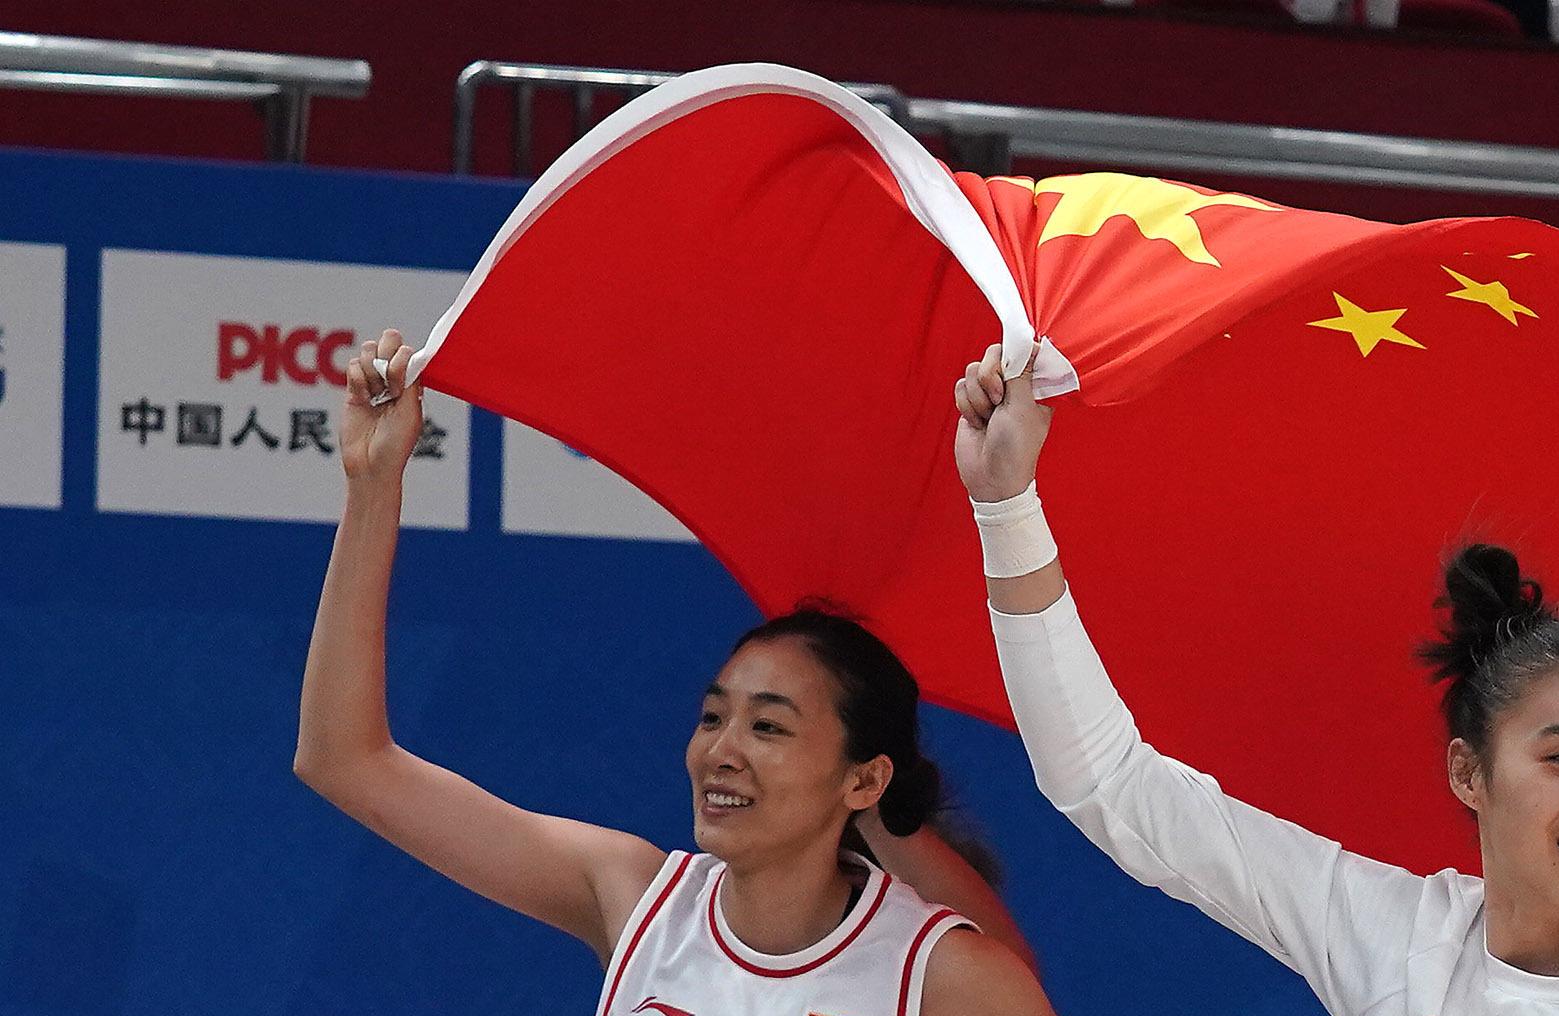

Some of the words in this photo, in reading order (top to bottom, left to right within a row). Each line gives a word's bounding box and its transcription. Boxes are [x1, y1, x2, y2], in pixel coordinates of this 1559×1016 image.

[216, 321, 355, 388] PICC
[120, 398, 446, 460] 中国人民
